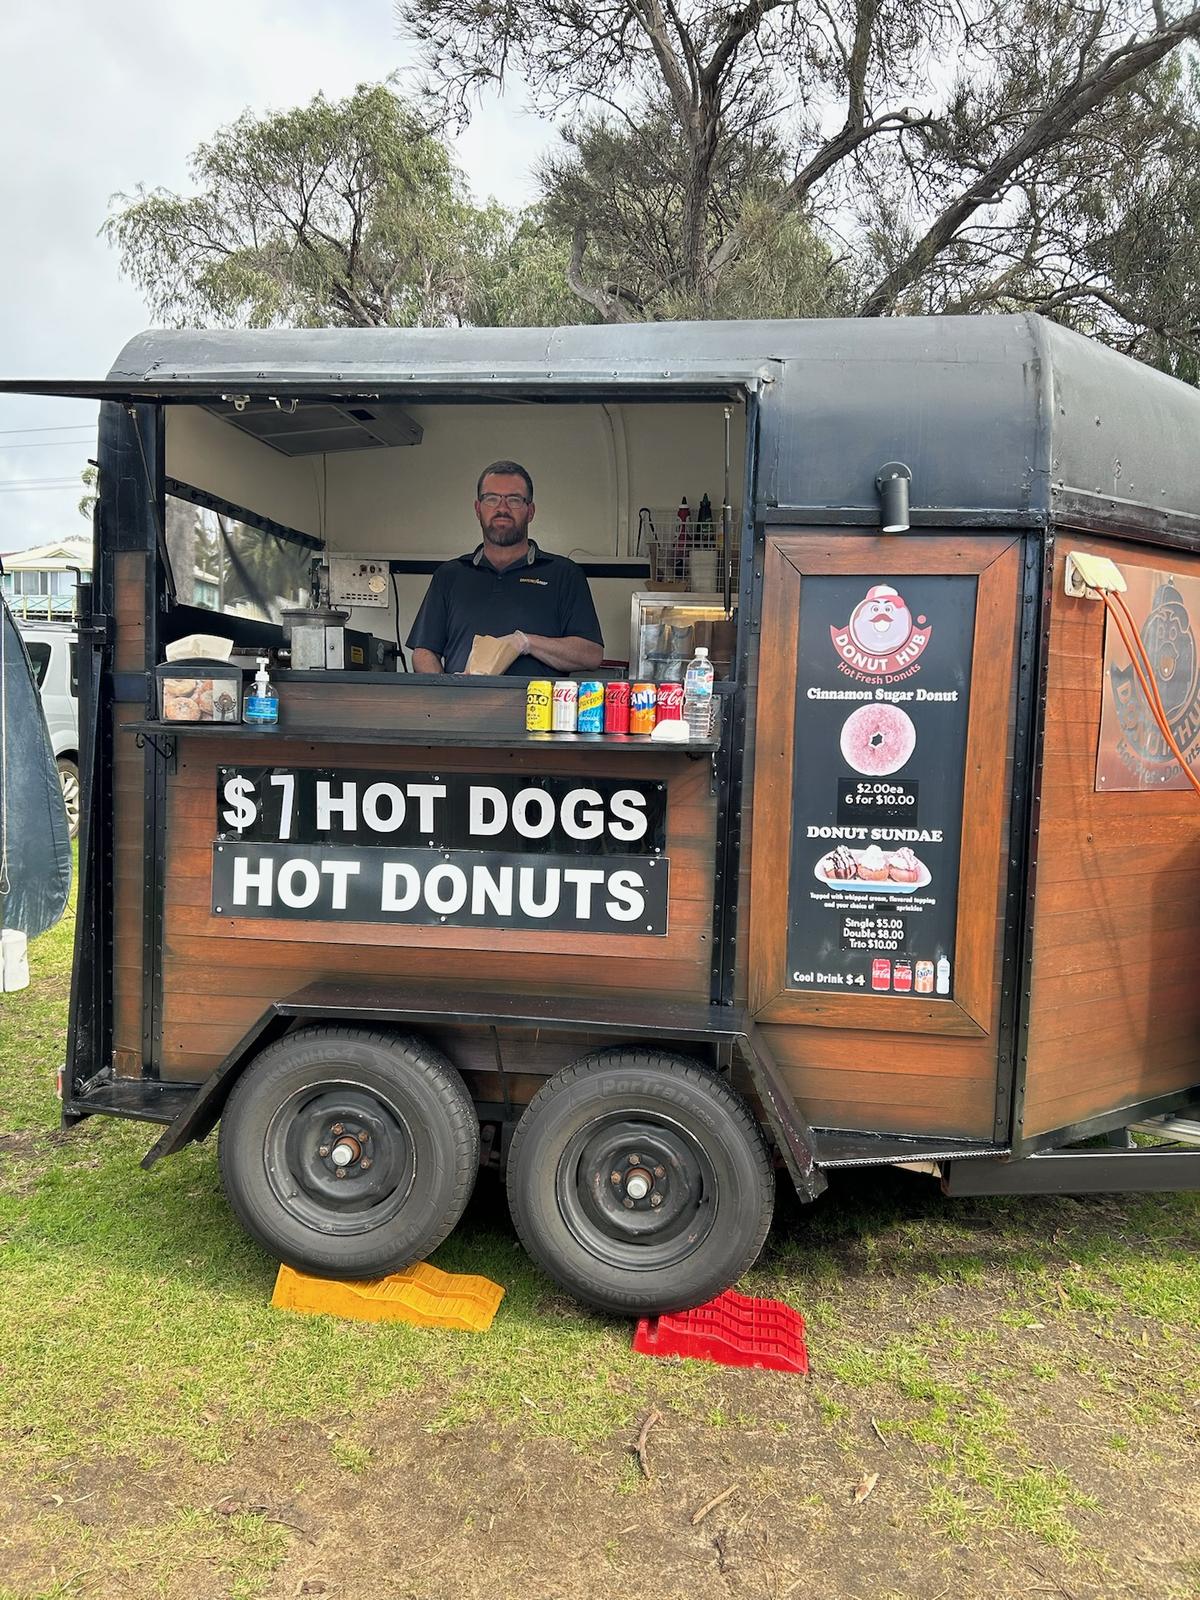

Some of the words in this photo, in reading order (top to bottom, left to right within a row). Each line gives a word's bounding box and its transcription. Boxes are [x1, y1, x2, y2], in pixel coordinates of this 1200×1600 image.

[835, 634, 888, 671] DONUT
[895, 634, 926, 666] HUB
[837, 661, 856, 678] Hot
[856, 672, 883, 684] Fresh
[885, 663, 921, 684] Donuts
[807, 687, 873, 700] Cinnamon
[875, 688, 914, 703] Sugar
[916, 689, 959, 701] Donut
[857, 783, 904, 794] $2.00ea
[845, 794, 854, 804] 6
[855, 794, 874, 804] for
[876, 794, 915, 805] $10.00
[316, 781, 447, 833] HOT
[469, 785, 649, 841] DOGS
[807, 826, 868, 840] DONUT
[871, 828, 943, 842] SUNDAE
[232, 857, 360, 909] HOT
[381, 862, 646, 921] DONUTS
[810, 892, 830, 901] Topped
[844, 893, 868, 902] whipped
[914, 897, 936, 905] topping
[896, 904, 923, 912] sprinkles
[845, 917, 875, 929] Single
[876, 918, 903, 929] $5.00
[843, 927, 876, 938] Double
[877, 929, 904, 940] $8.00
[849, 938, 867, 948] Trio
[867, 939, 898, 950] $10.00
[793, 971, 814, 982] Cool
[816, 972, 843, 984] Drink
[846, 974, 866, 986] $4
